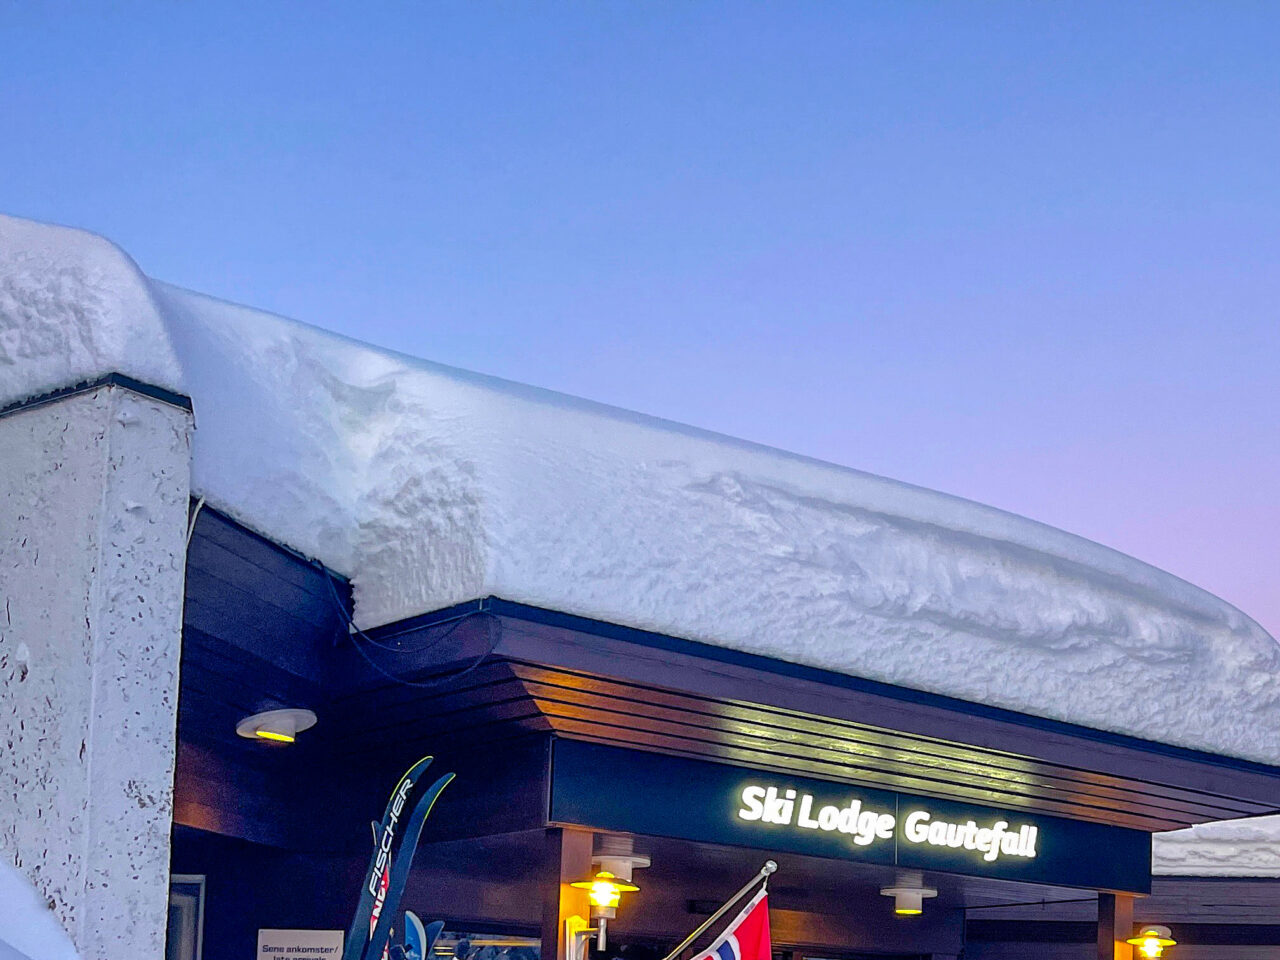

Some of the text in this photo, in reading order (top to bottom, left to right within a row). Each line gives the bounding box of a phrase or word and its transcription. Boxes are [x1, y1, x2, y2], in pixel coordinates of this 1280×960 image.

[369, 779, 413, 897] FISCHER
[738, 785, 1039, 863] Ski Lodge Gautefall
[262, 945, 338, 954] Sene ankomster/
